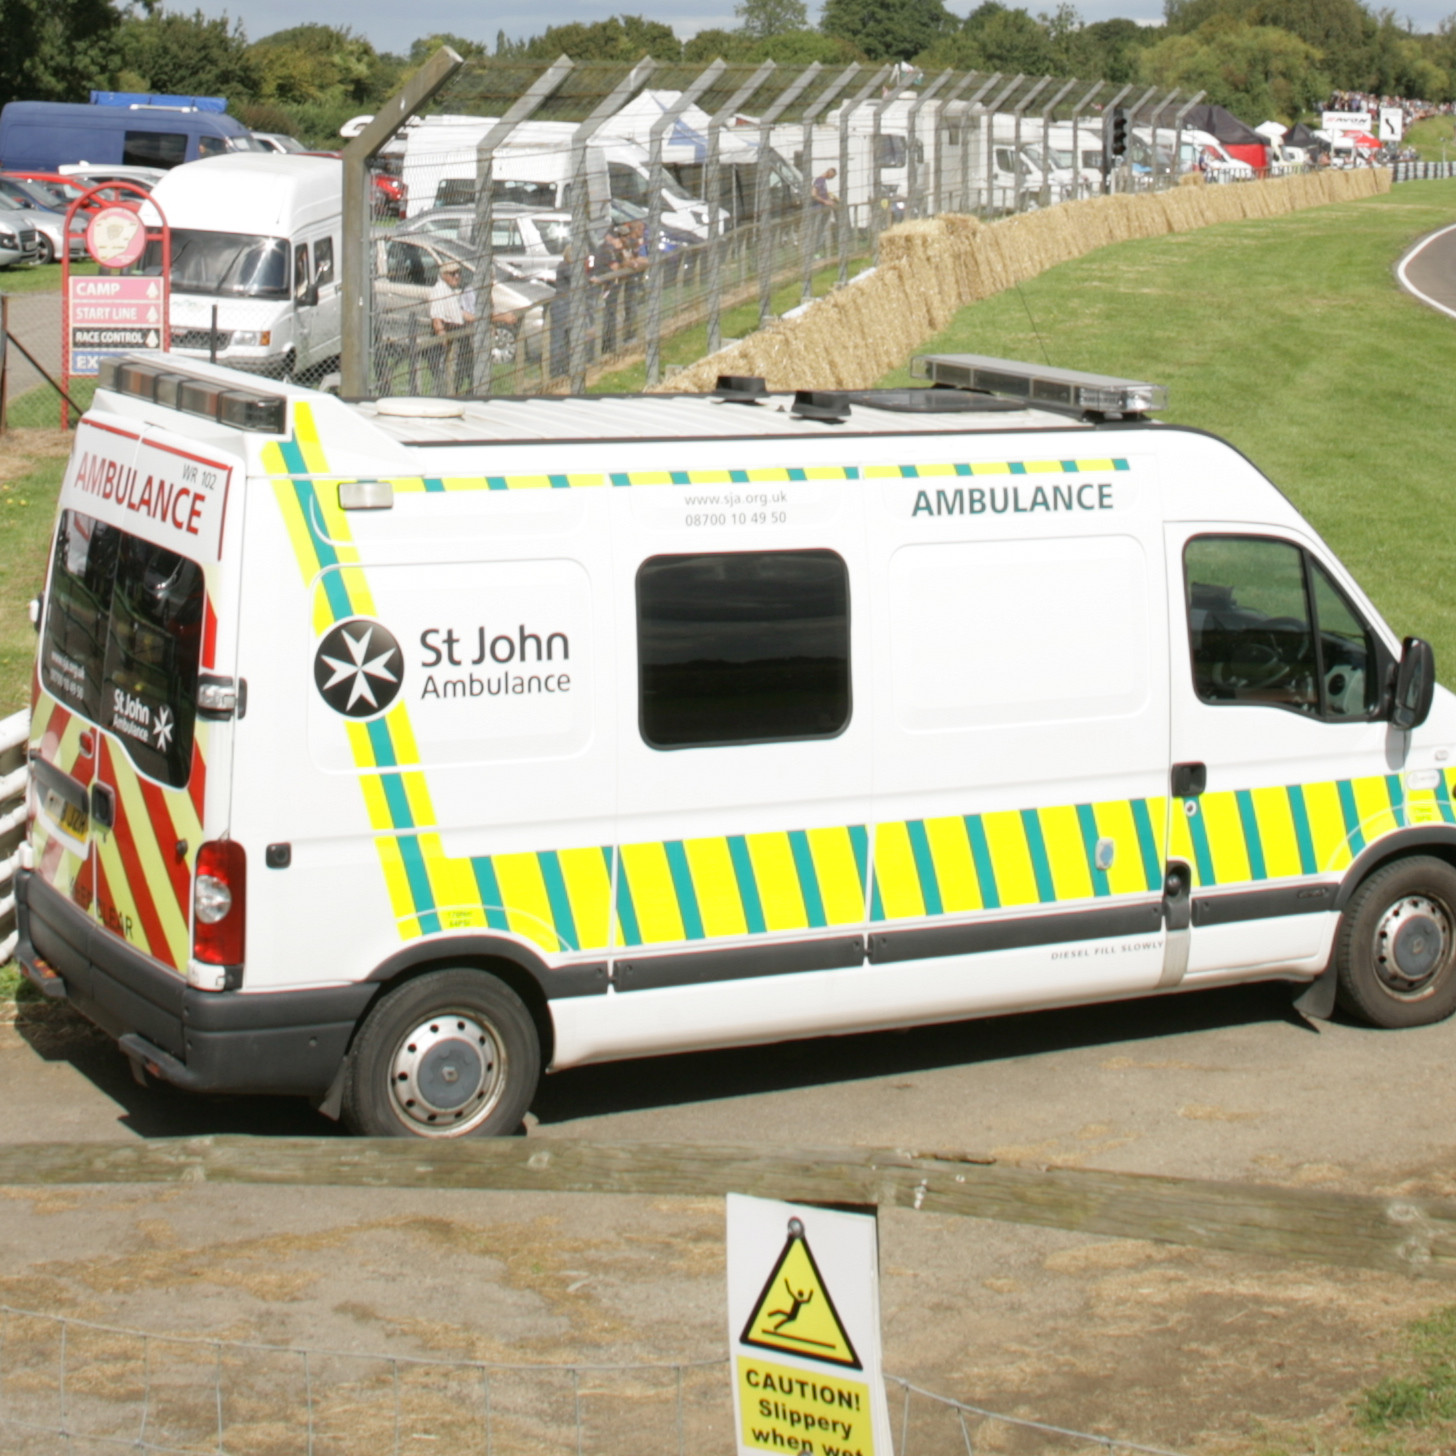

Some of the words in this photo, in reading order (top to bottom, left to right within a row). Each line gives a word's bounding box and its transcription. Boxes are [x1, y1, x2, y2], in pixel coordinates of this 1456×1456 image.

[76, 282, 120, 296] CAMP
[75, 307, 110, 320] START
[112, 307, 137, 320] LINE
[75, 331, 99, 343] RACE
[101, 331, 144, 344] CONTROL
[182, 463, 198, 483] WR
[201, 471, 217, 491] 102
[74, 451, 206, 535] AMBULANCE
[684, 489, 788, 508] www.sja.org.uk
[912, 483, 1114, 517] AMBULANCE
[685, 512, 726, 527] 08700
[732, 512, 747, 525] 10
[750, 511, 767, 524] 49
[771, 510, 787, 524] 50
[420, 628, 462, 668] St
[472, 624, 569, 665] John
[420, 670, 571, 700] Ambulance
[114, 688, 124, 714] St
[124, 693, 149, 725] John
[113, 713, 149, 742] Ambulance
[1051, 949, 1089, 960] DIESEL
[1095, 945, 1117, 956] FILL
[1121, 941, 1165, 953] SLOWLY
[745, 1368, 861, 1412] CAUTION!
[758, 1398, 853, 1441] Slippery
[751, 1426, 814, 1454] when
